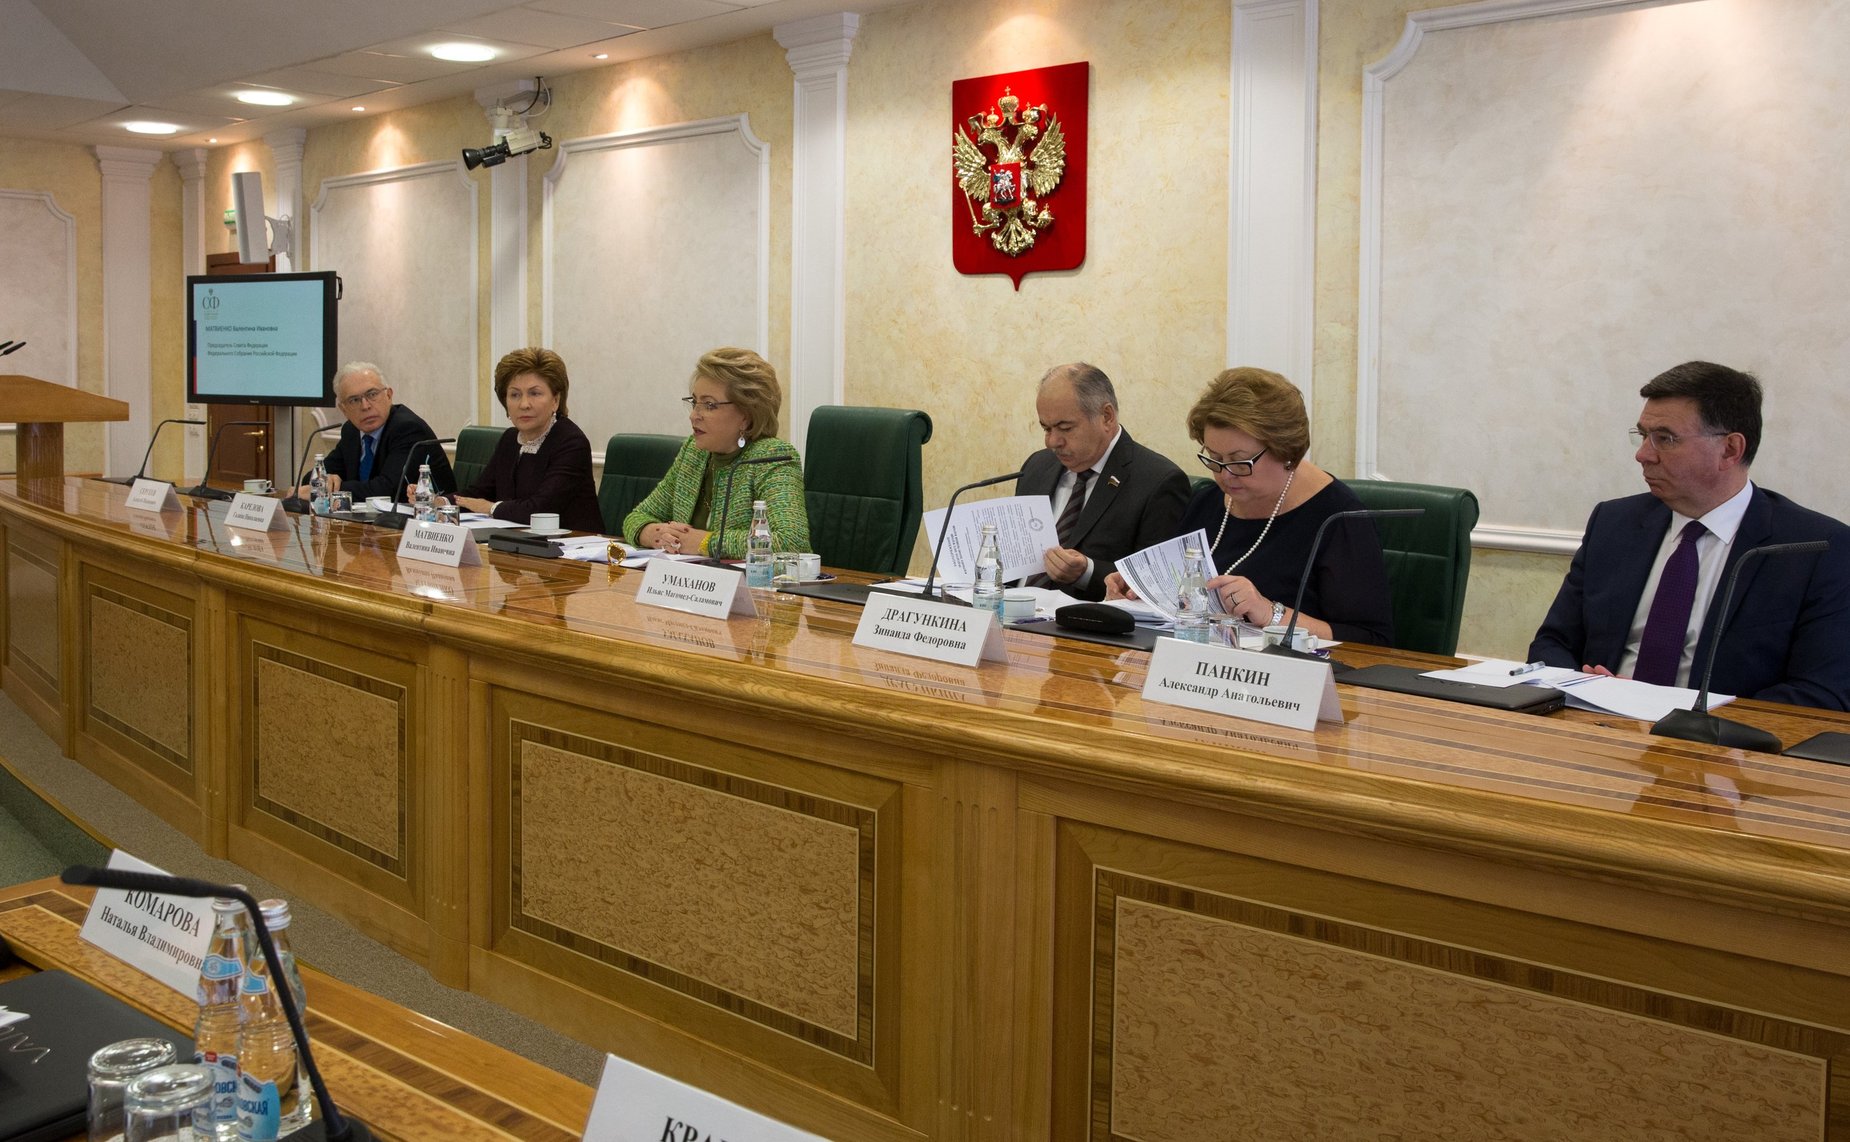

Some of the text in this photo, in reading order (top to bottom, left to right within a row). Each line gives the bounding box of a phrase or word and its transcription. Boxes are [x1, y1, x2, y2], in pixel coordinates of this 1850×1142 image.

[202, 296, 220, 310] СФ
[405, 541, 430, 552] Валентина
[414, 529, 455, 544] МАТВИЕНКО
[646, 586, 665, 596] Ильяс
[662, 574, 716, 592] УМАХАНОВ
[881, 608, 967, 632] ДРАГУНКИНА
[873, 624, 967, 650] Зинаида Федоровна
[1195, 661, 1271, 687] ПАНКИН
[1158, 677, 1219, 699] Александр
[124, 889, 201, 938] КОМАРОВА
[100, 906, 203, 971] Наталья Владимировн
